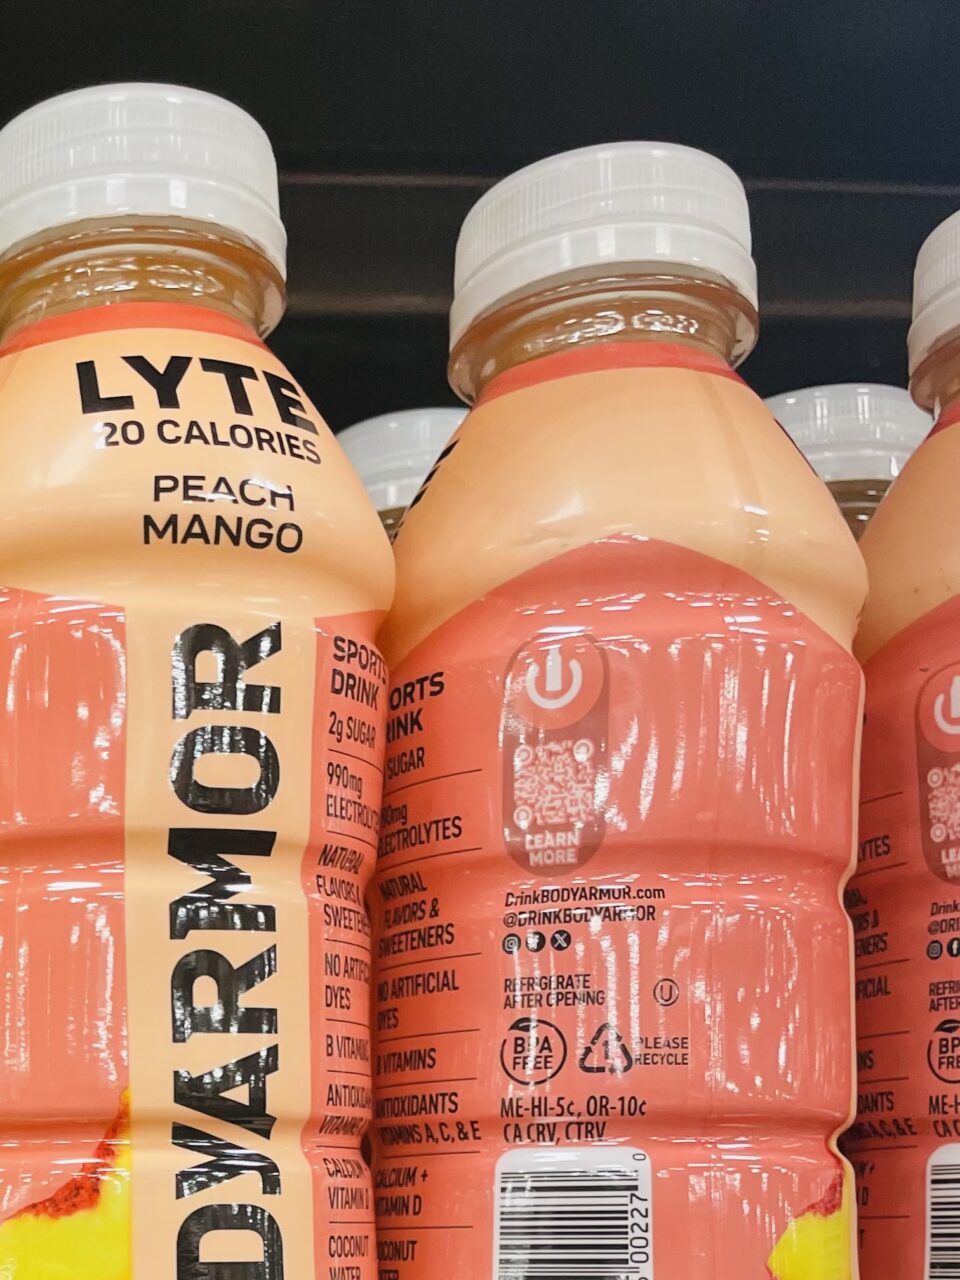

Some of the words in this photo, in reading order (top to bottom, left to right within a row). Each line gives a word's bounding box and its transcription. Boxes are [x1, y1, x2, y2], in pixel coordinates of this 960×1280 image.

[76, 355, 320, 436] LYTE
[100, 420, 145, 447] 20
[156, 419, 322, 465] CALORIES
[153, 475, 295, 512] PEACH
[143, 513, 304, 554] MANGO
[330, 668, 380, 711] DRINK
[329, 711, 344, 744] 2g
[346, 716, 376, 750] SUGAR
[387, 747, 425, 780] SUGAR
[327, 762, 363, 800] 990mg
[525, 832, 580, 851] LEARN
[318, 844, 365, 875] NATURAL
[529, 849, 577, 866] MORE
[505, 885, 666, 907] DrinkBODYARMOR.com
[429, 898, 440, 919] &
[379, 922, 455, 958] SWEETENERS
[325, 953, 340, 977] NO
[391, 969, 460, 998] ARTIFICIAL
[504, 974, 591, 992] REFRIGERATE
[325, 985, 351, 1010] DYES
[504, 992, 542, 1010] AFTER
[546, 990, 605, 1007] OPENING
[326, 1034, 333, 1057] B
[638, 1037, 689, 1050] PLEASE
[382, 1048, 437, 1073] VITAMINS
[635, 1053, 689, 1066] RECYCLE
[426, 1123, 439, 1143] A,
[440, 1122, 455, 1143] C,
[457, 1122, 470, 1141] &
[472, 1120, 482, 1140] E
[503, 1122, 523, 1143] CA
[527, 1122, 560, 1145] CRV,
[565, 1121, 606, 1142] CTRV
[327, 1187, 363, 1209] VITAMIN
[413, 1195, 422, 1216] D
[629, 1193, 649, 1264] 00227
[328, 1235, 369, 1258] COCONUT
